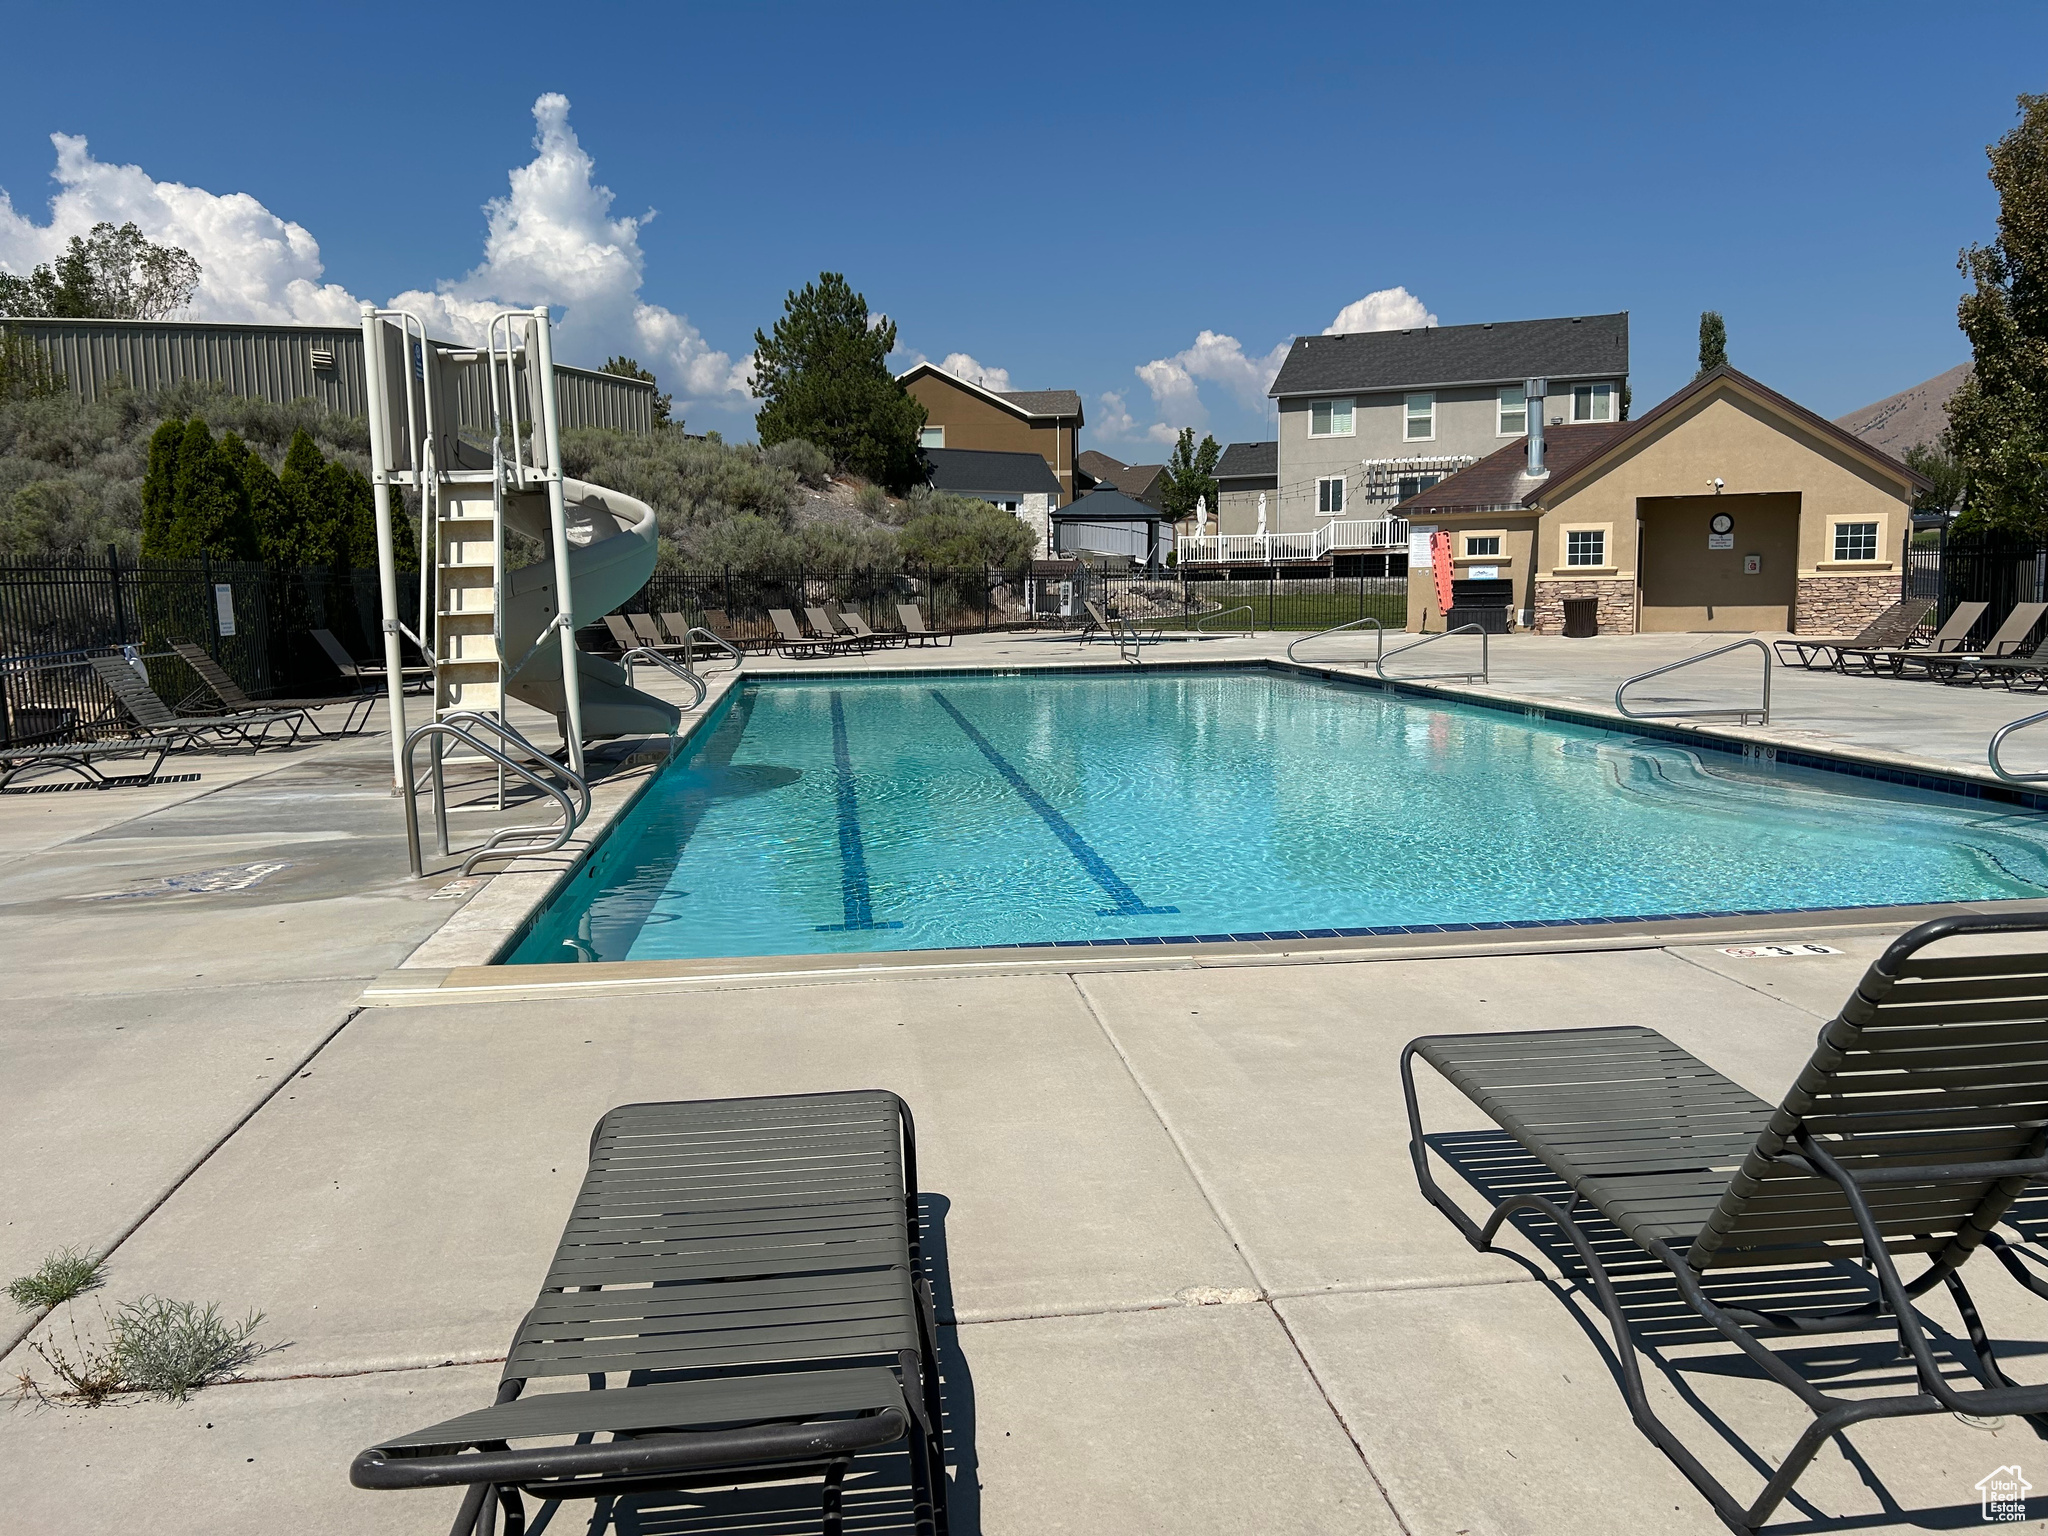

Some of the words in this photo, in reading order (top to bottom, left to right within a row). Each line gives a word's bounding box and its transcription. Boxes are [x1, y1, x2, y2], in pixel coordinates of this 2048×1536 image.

[1744, 744, 1749, 756] 3
[1754, 746, 1760, 758] 6
[1766, 946, 1794, 955] 3
[1802, 944, 1830, 953] 6
